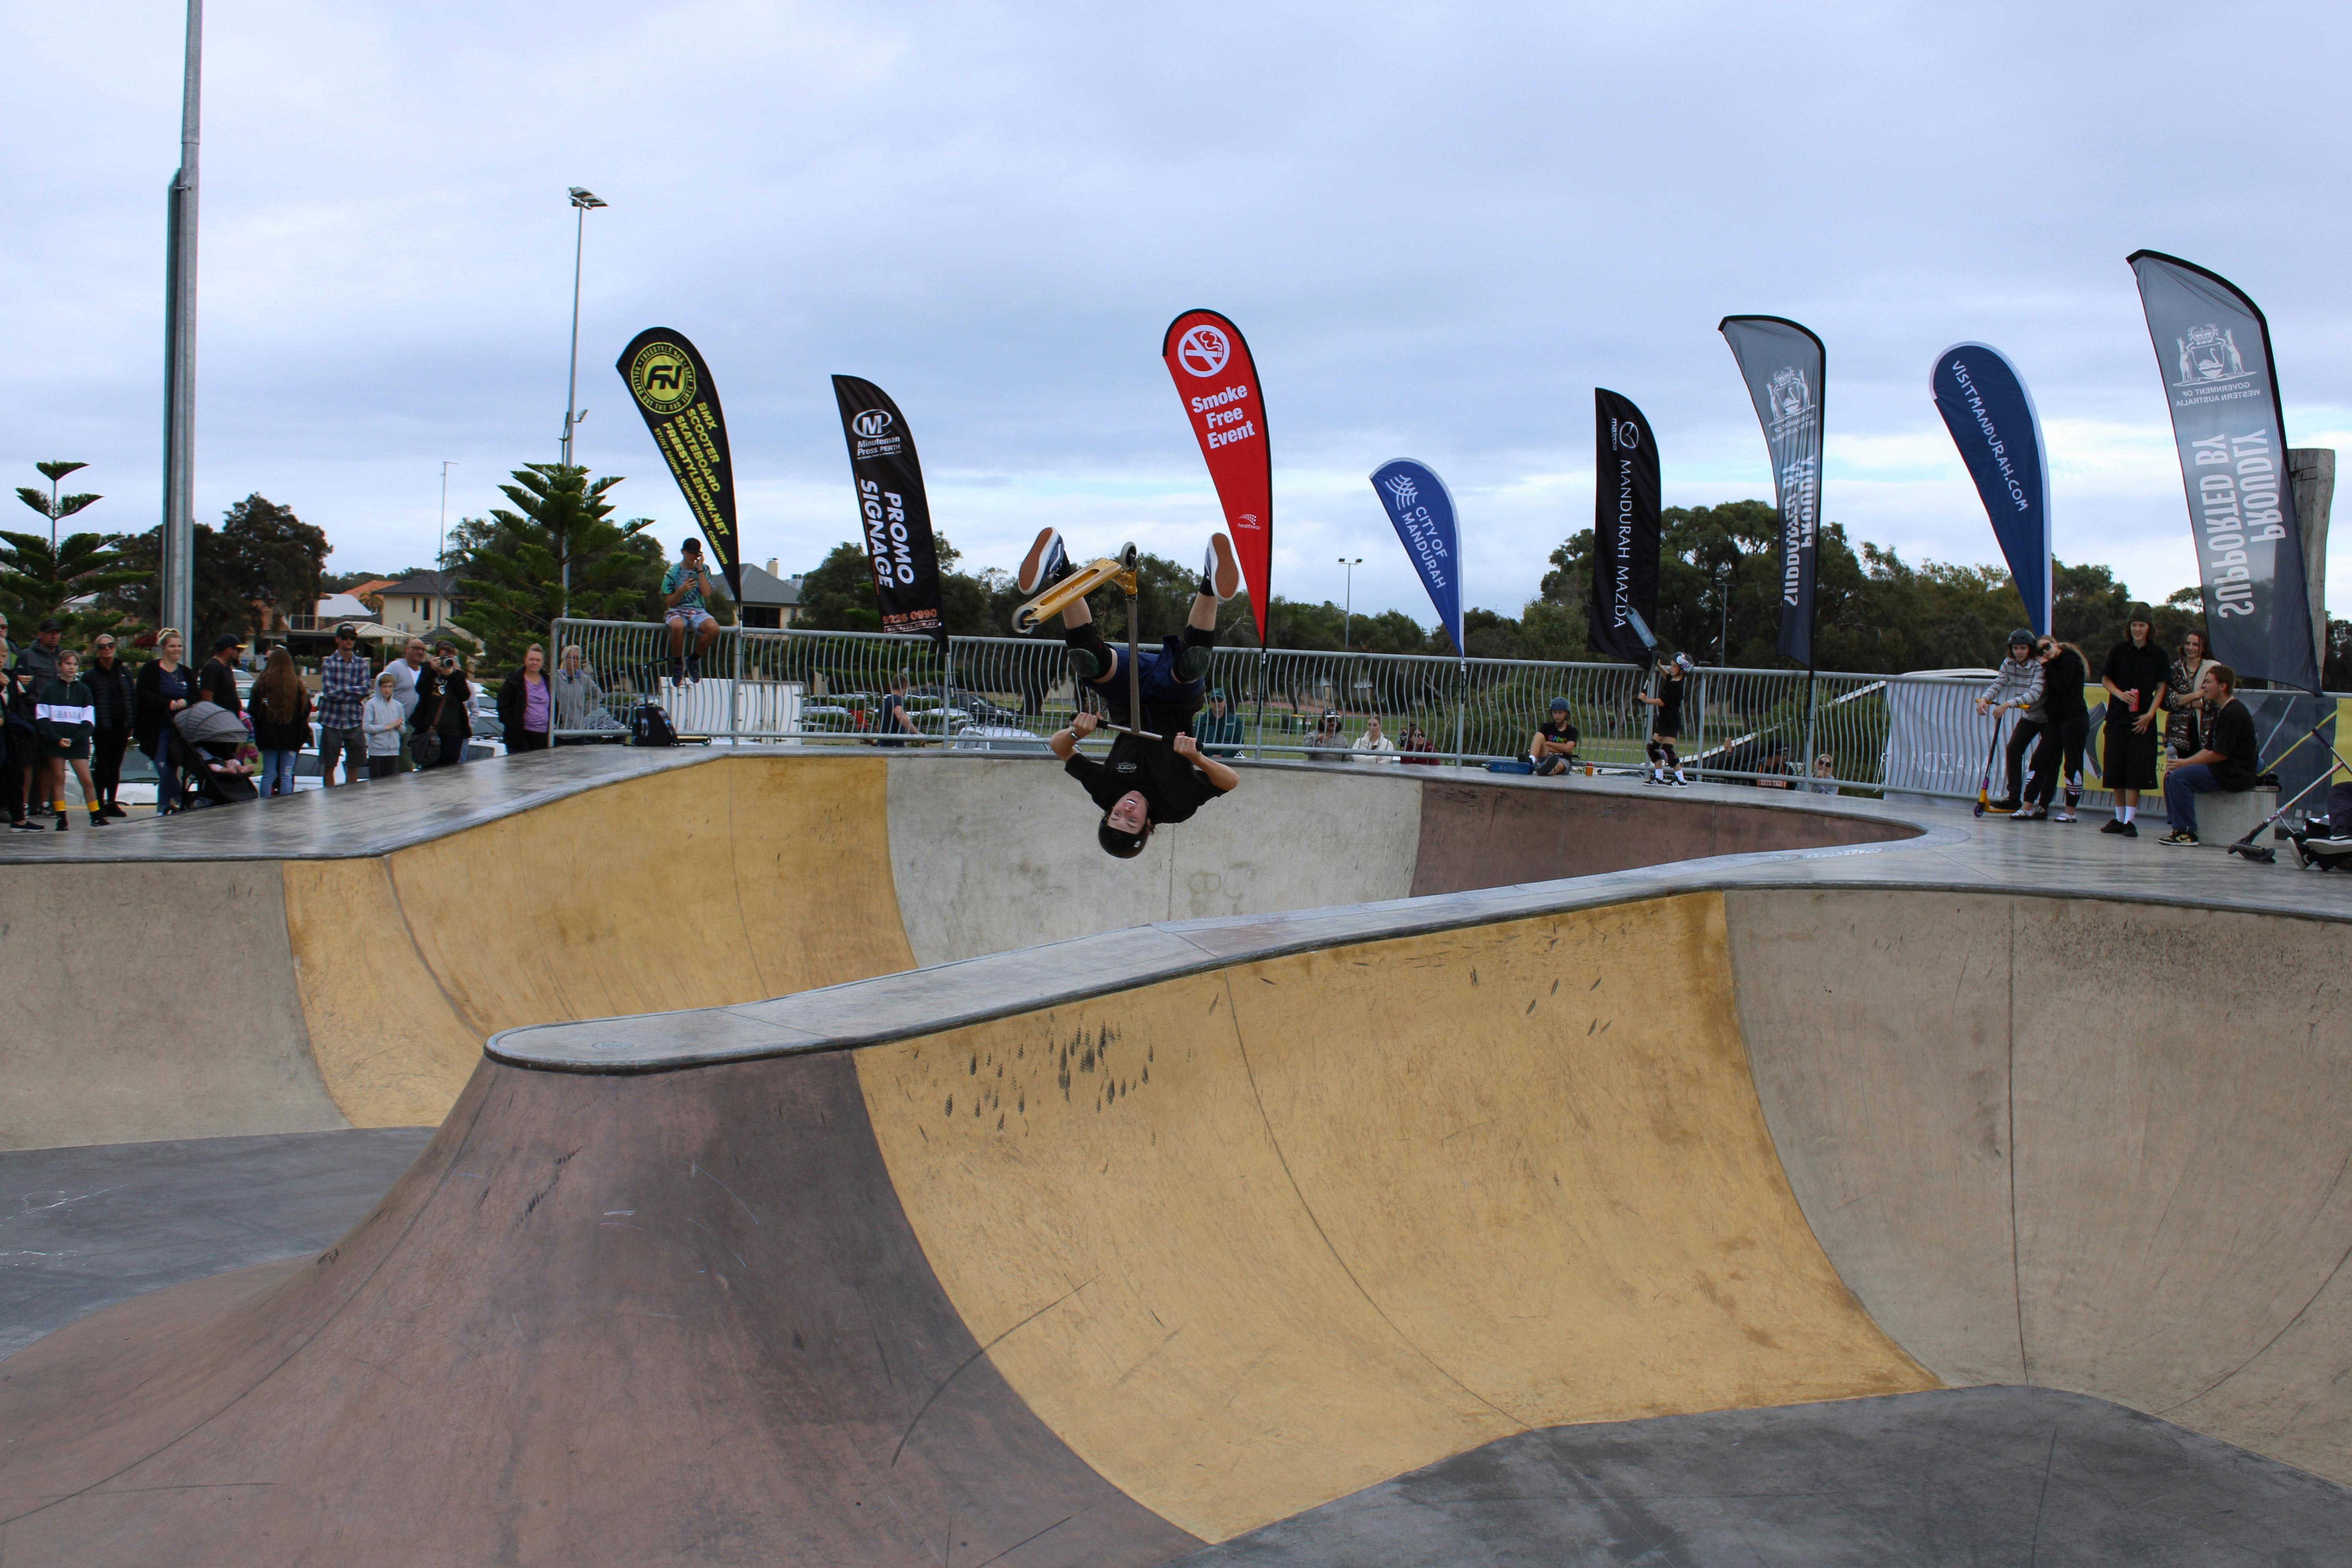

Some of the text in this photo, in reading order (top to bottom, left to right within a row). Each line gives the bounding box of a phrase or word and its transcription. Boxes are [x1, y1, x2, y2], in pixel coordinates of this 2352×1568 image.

[640, 346, 672, 361] FREESTYLE
[696, 402, 718, 430] BMX
[1191, 384, 1248, 414] Smoke
[1205, 407, 1243, 429] Free
[675, 415, 720, 492] SKATEBOARD
[686, 408, 720, 463] SCOOTER
[857, 447, 878, 456] Press
[858, 436, 900, 448] Minuteman
[1207, 420, 1255, 449] Event
[1952, 360, 2029, 512] VISITMANDURAH.COM
[654, 427, 728, 564] STUNT SHOWS COMPETITIONS COACHING
[662, 422, 730, 535] FREESTYLENOW.NET
[860, 478, 894, 588] SIGNAGE
[884, 492, 914, 584] PROMO
[1402, 512, 1446, 588] MANDURAH
[1416, 506, 1448, 557] CITY OF
[1614, 459, 1632, 628] MANDURAH MAZDA
[883, 608, 937, 624] 9226 0990
